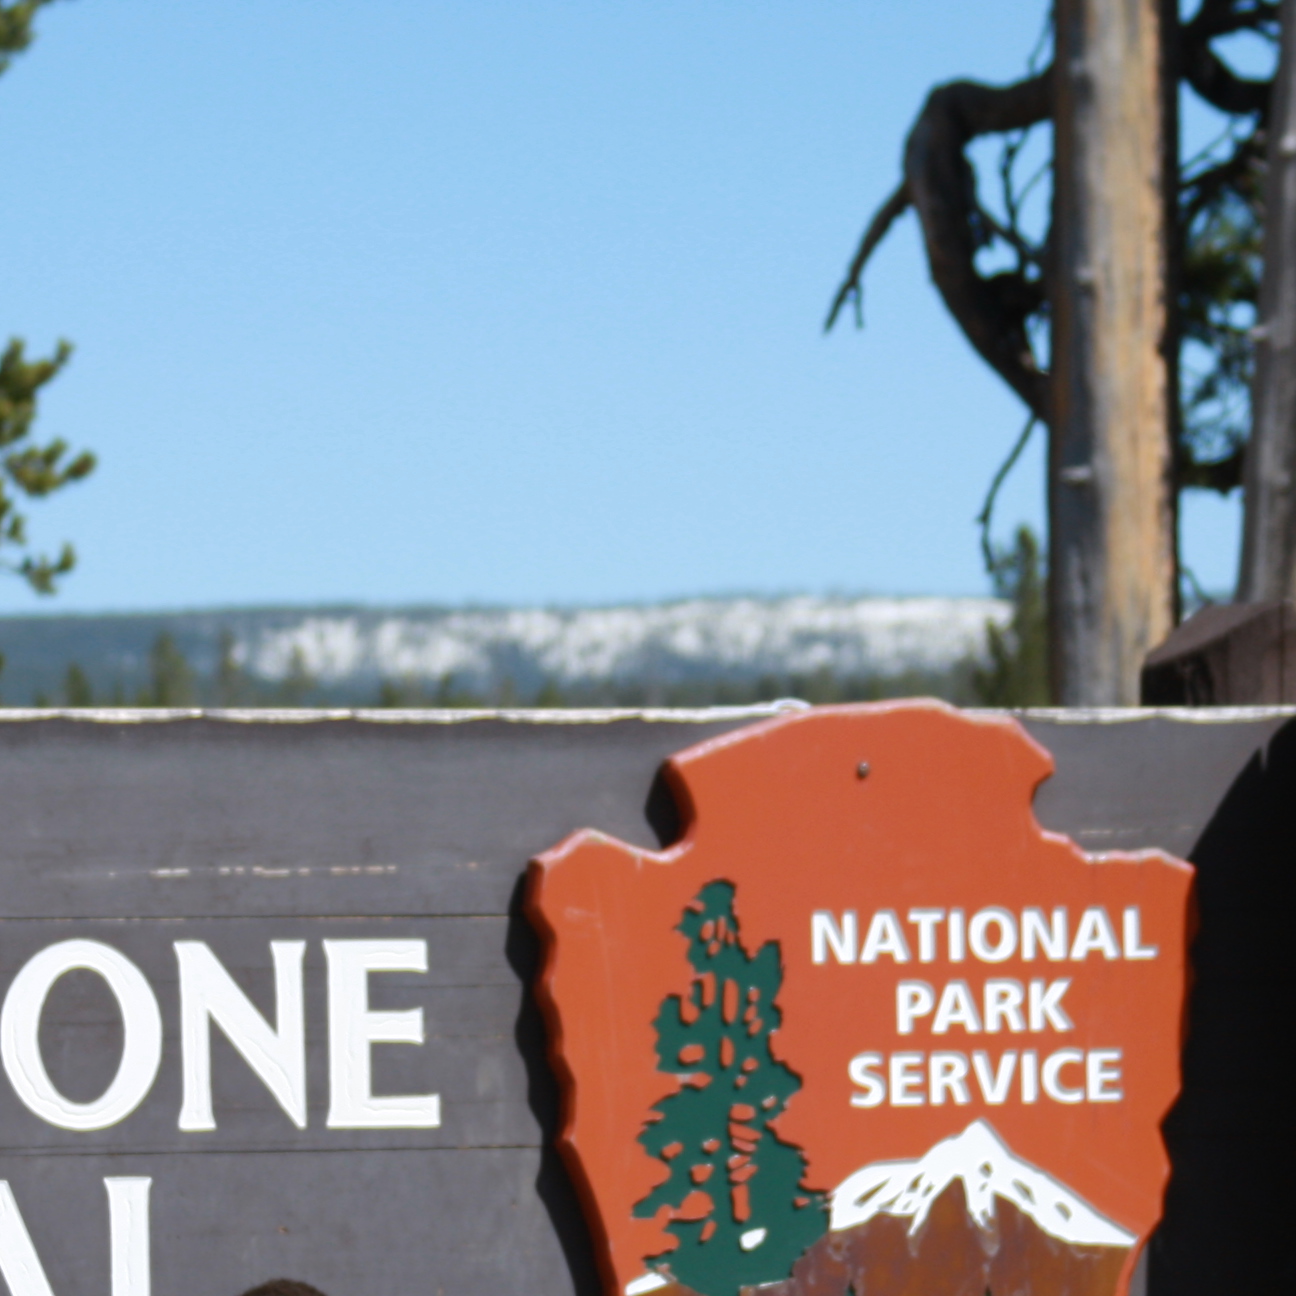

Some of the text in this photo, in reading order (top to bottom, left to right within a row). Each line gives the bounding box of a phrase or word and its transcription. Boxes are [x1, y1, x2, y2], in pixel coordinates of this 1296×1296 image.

[810, 905, 1158, 965] NATIONAL
[895, 977, 1074, 1035] PARK
[847, 1046, 1124, 1108] SERVICE
